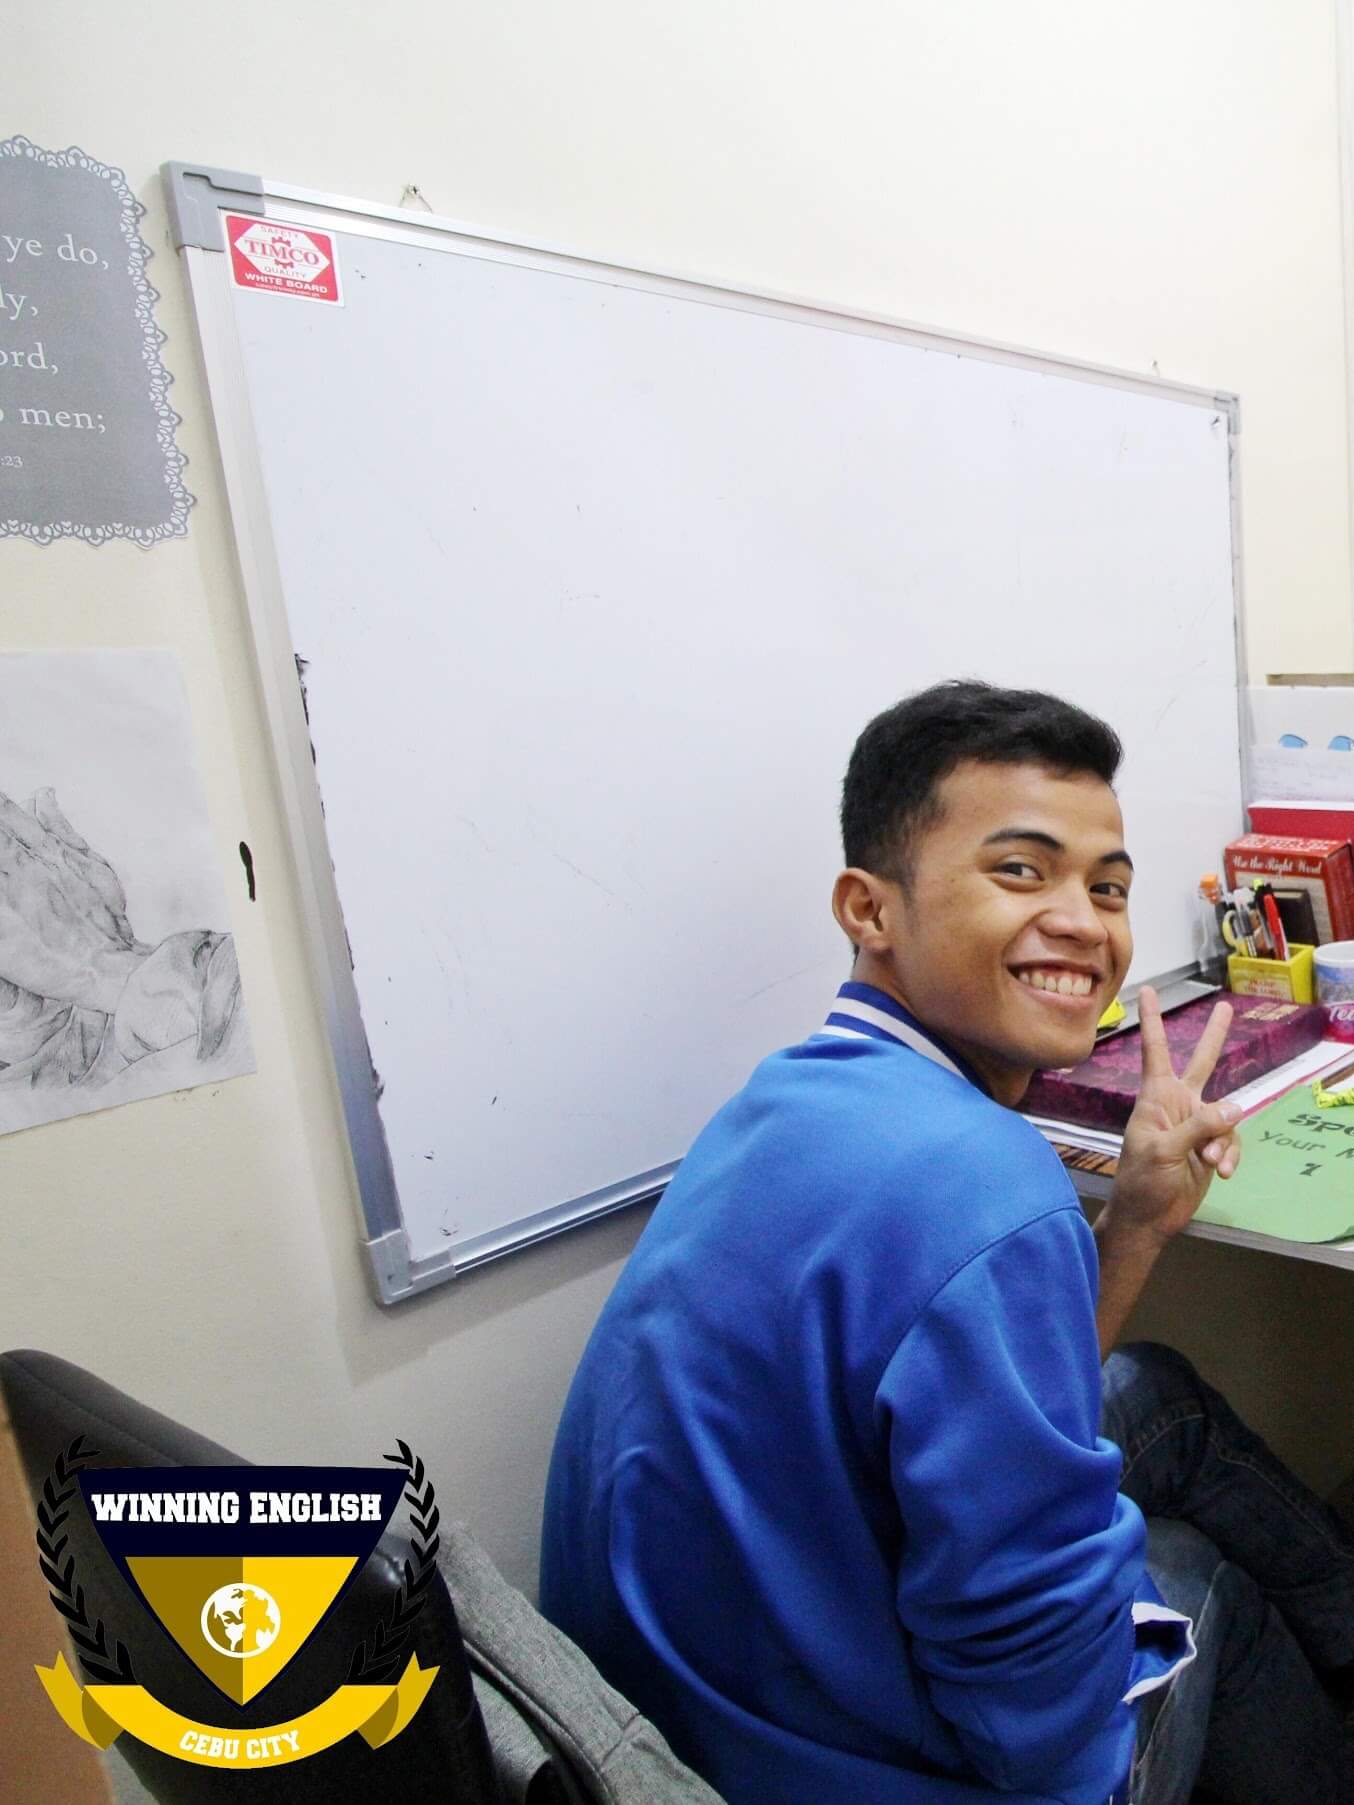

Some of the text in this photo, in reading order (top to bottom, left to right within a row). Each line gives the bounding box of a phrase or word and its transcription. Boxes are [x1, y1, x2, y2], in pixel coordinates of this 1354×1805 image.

[2, 233, 109, 270] ye do,
[244, 239, 320, 266] TIMCO
[244, 272, 283, 286] WHITE
[286, 279, 329, 294] BOARD
[263, 265, 307, 279] QUALITY
[19, 406, 106, 433] men;
